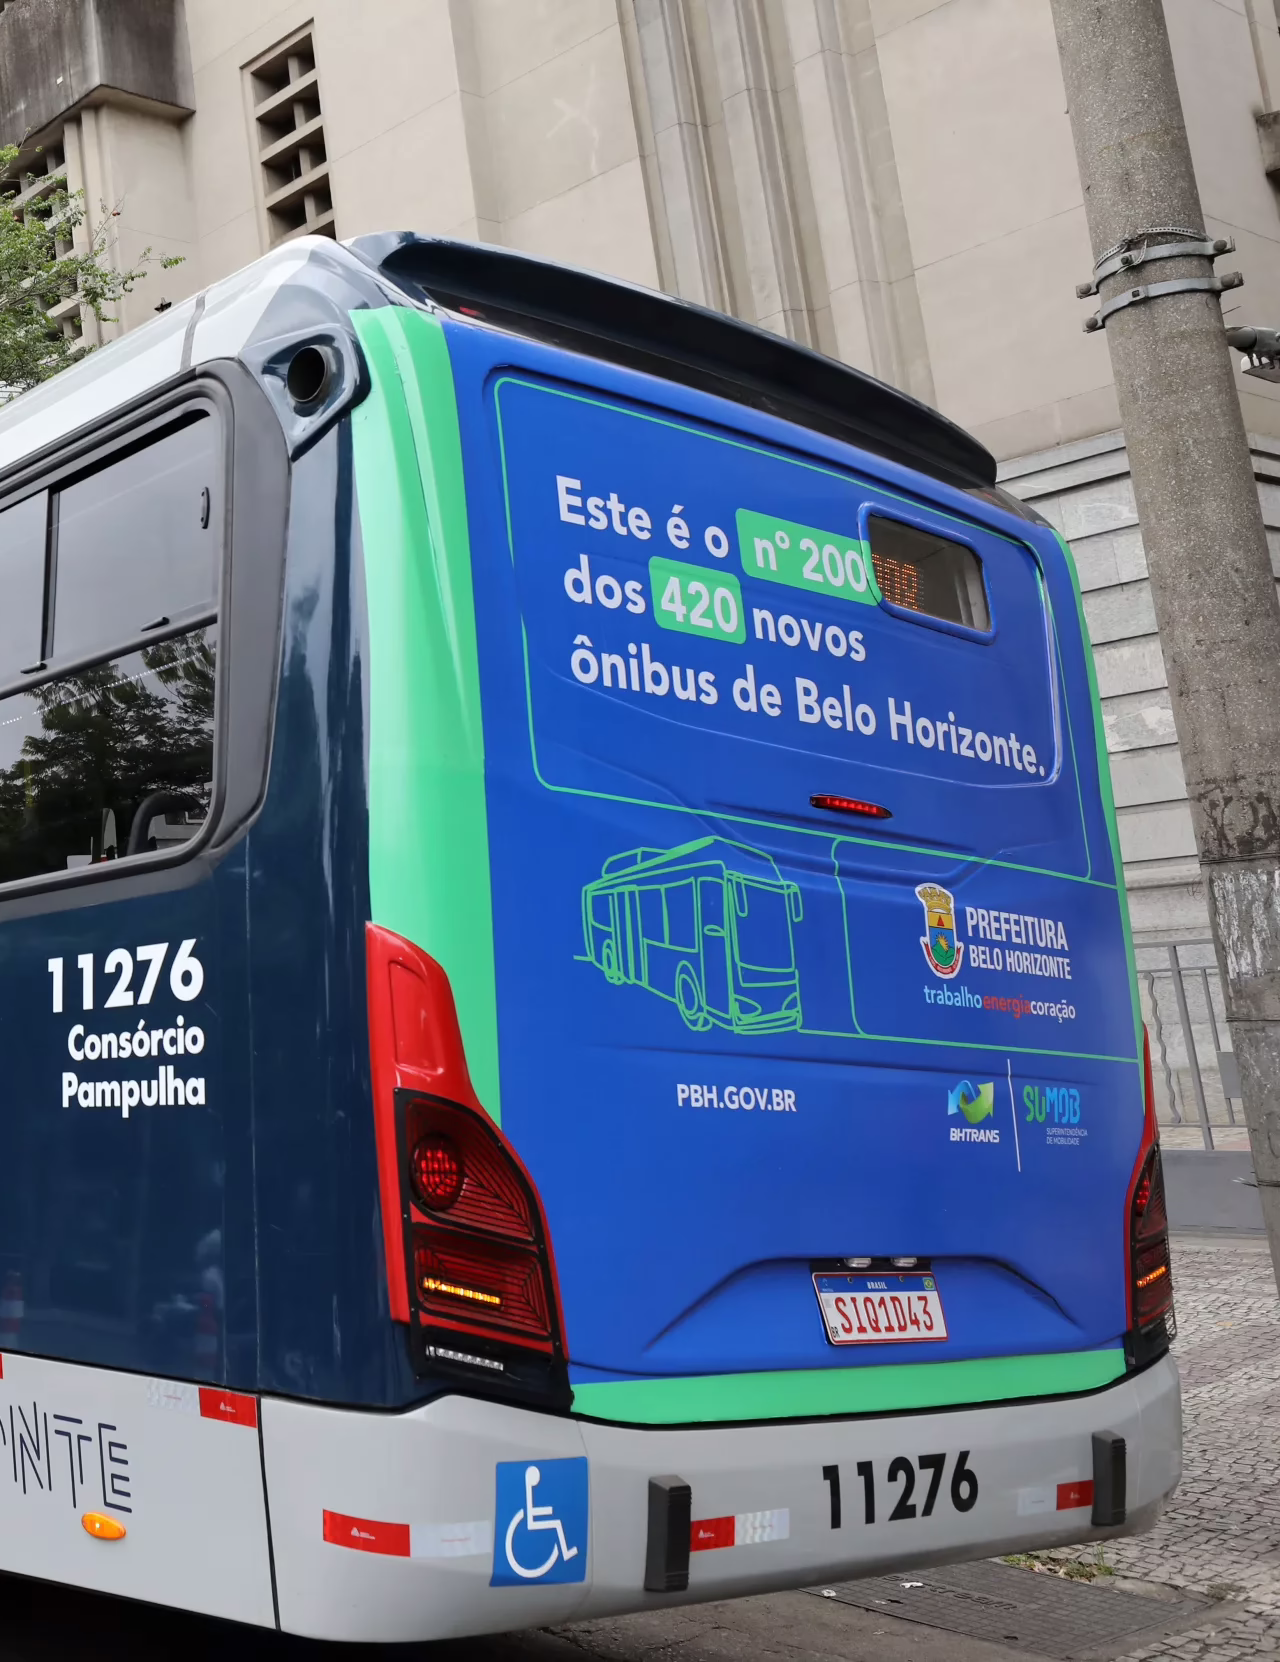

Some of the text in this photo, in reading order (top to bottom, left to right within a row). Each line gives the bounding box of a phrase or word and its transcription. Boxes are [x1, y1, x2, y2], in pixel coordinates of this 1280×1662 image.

[556, 475, 652, 540] Este
[666, 504, 690, 549] é
[705, 526, 729, 558] o
[799, 538, 868, 593] 200
[563, 553, 866, 662] dos 420 novos
[571, 634, 1046, 776] ônibus de Belo Horizonte.
[965, 906, 1069, 951] PREFEITURA
[48, 938, 204, 1013] 11276
[969, 945, 1072, 980] BELO HORIZONTE
[68, 1015, 205, 1061] Consórcio
[62, 1065, 206, 1118] Pampulha
[676, 1083, 797, 1112] PBH.GOV.BR
[1023, 1084, 1081, 1124] SUMOB
[950, 1127, 1000, 1143] BHTRANS
[867, 1281, 888, 1290] BRASIL
[834, 1295, 934, 1334] SIQ1D43
[822, 1450, 978, 1529] 11276
